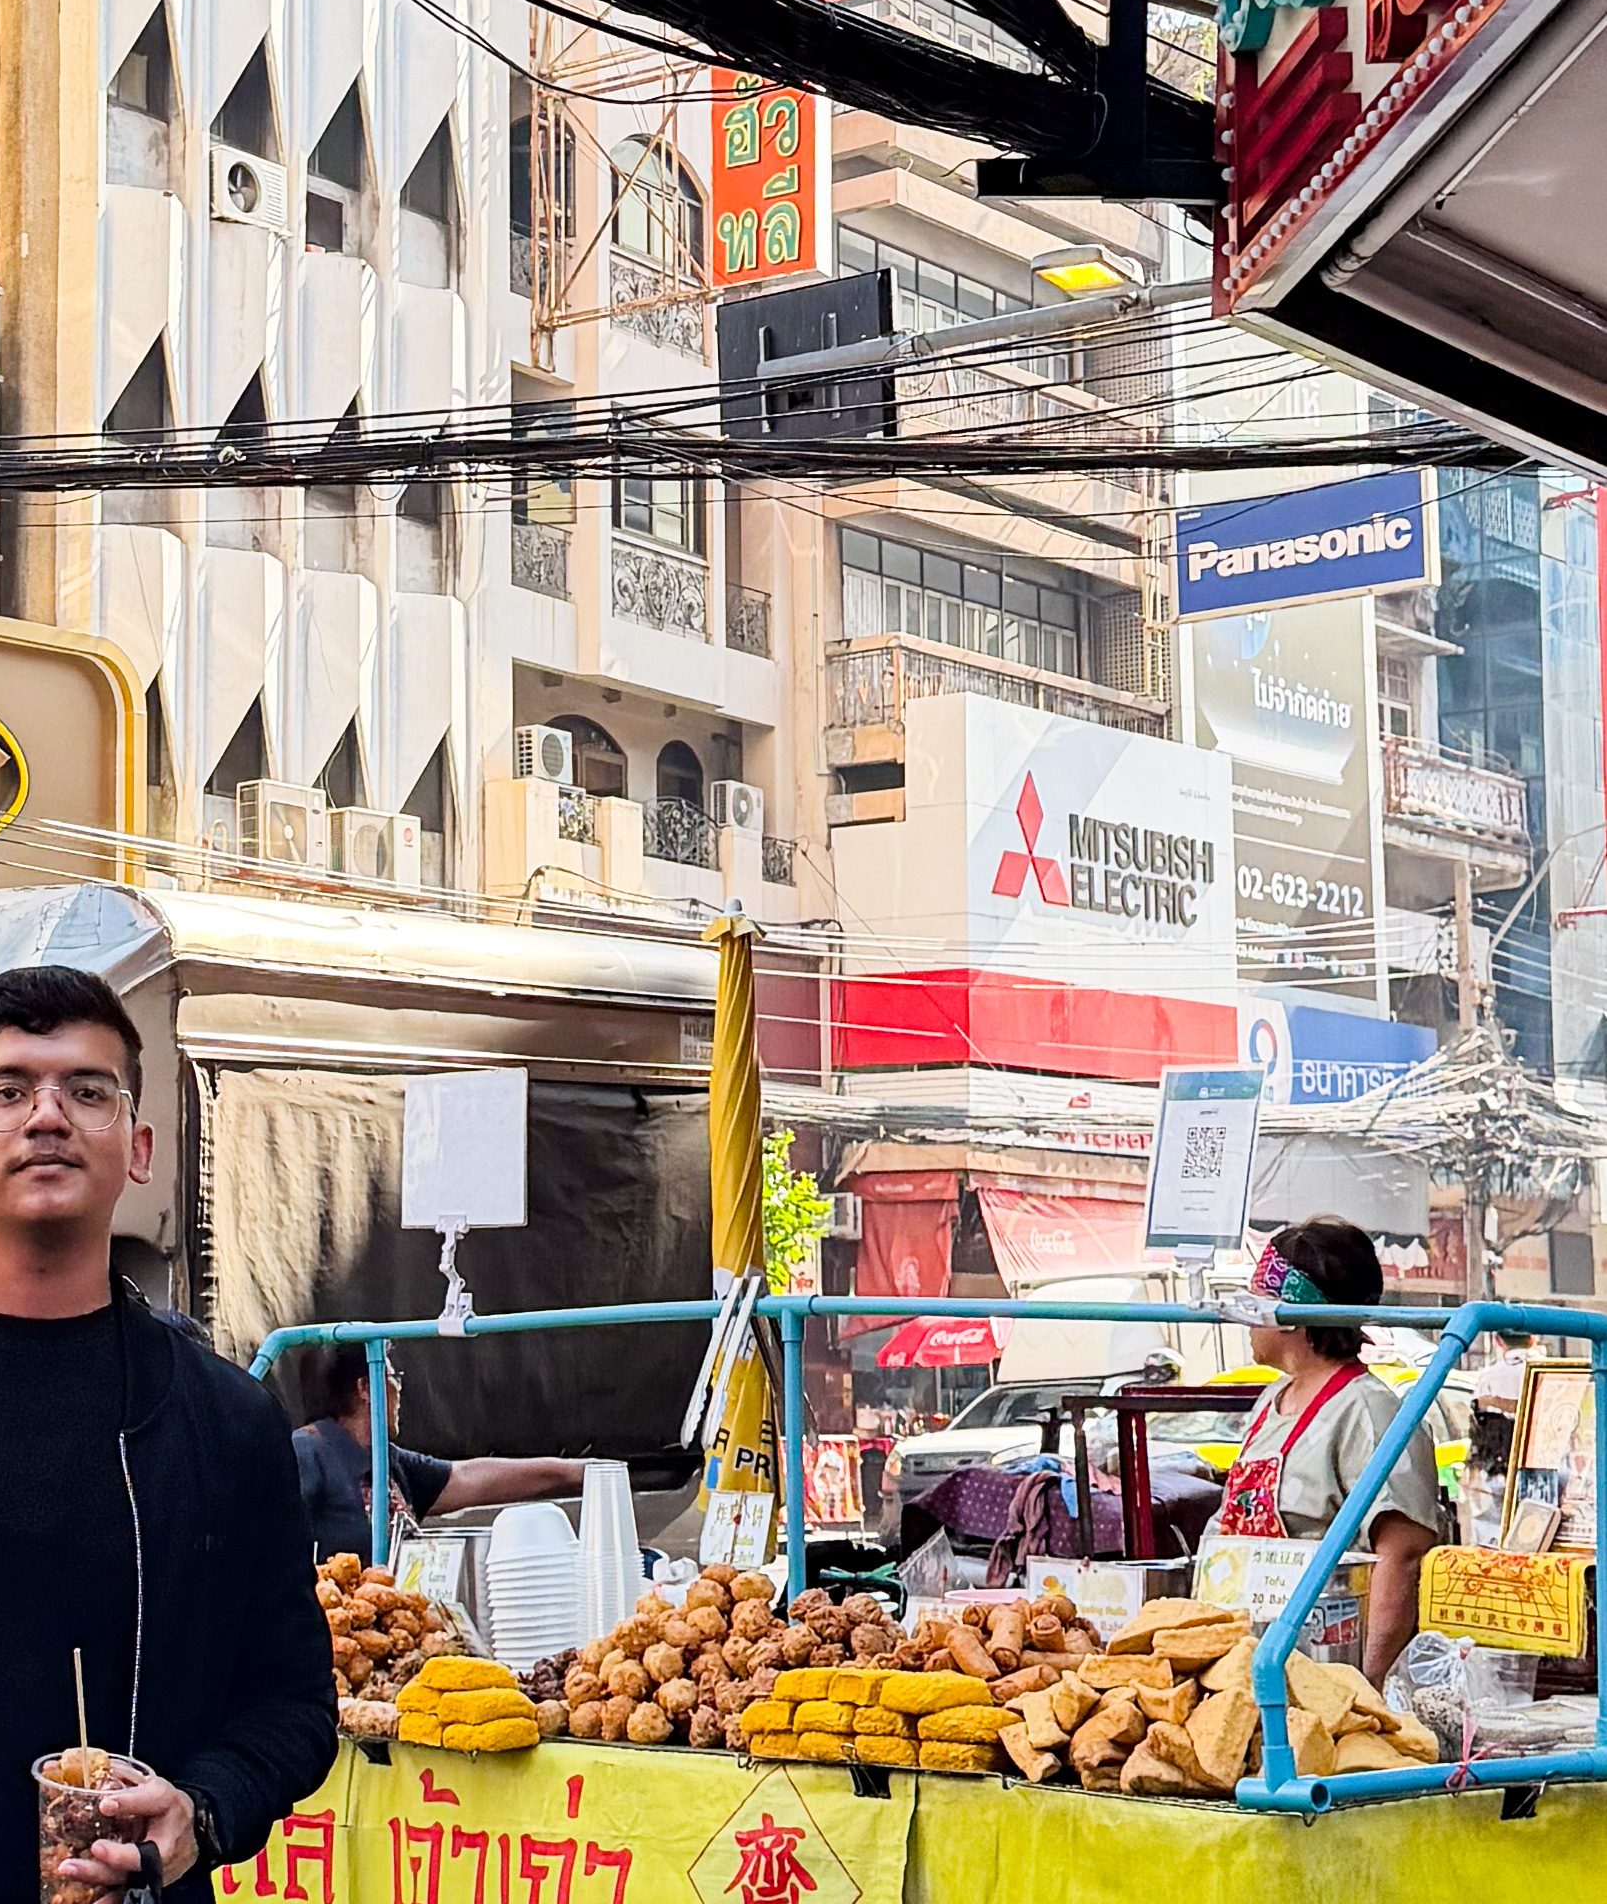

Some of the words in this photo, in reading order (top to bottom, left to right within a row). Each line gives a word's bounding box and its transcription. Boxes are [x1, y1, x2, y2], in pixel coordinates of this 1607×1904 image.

[717, 163, 801, 274] หลี
[1187, 511, 1414, 583] Panasonic
[1068, 813, 1216, 885] MITSUBISHI
[1069, 869, 1199, 929] ELECTRIC
[1237, 864, 1365, 919] 02-623-2212
[1269, 1594, 1290, 1605] Bah
